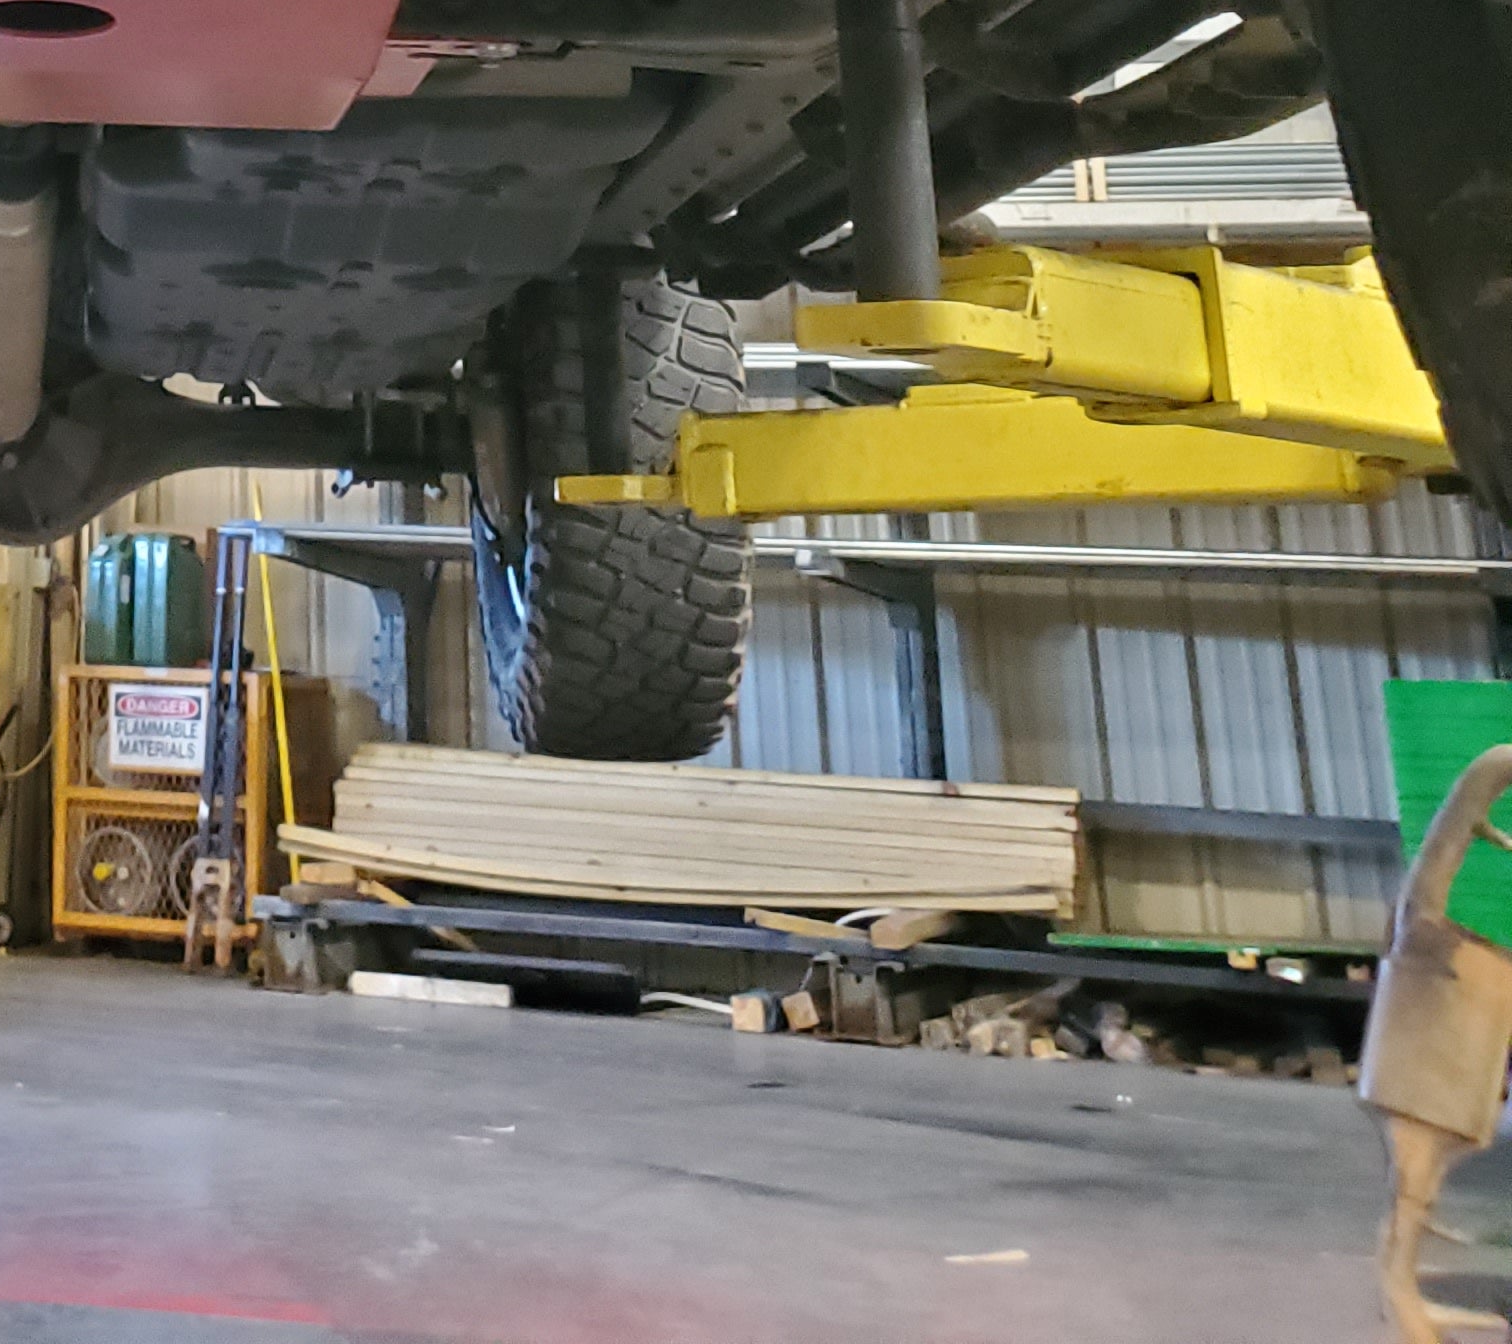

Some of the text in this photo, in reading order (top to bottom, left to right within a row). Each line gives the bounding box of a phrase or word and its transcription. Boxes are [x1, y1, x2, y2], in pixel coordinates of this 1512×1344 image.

[126, 698, 190, 715] DANGER
[116, 718, 199, 739] FLAMMABLE
[118, 739, 196, 759] MATERIALS
